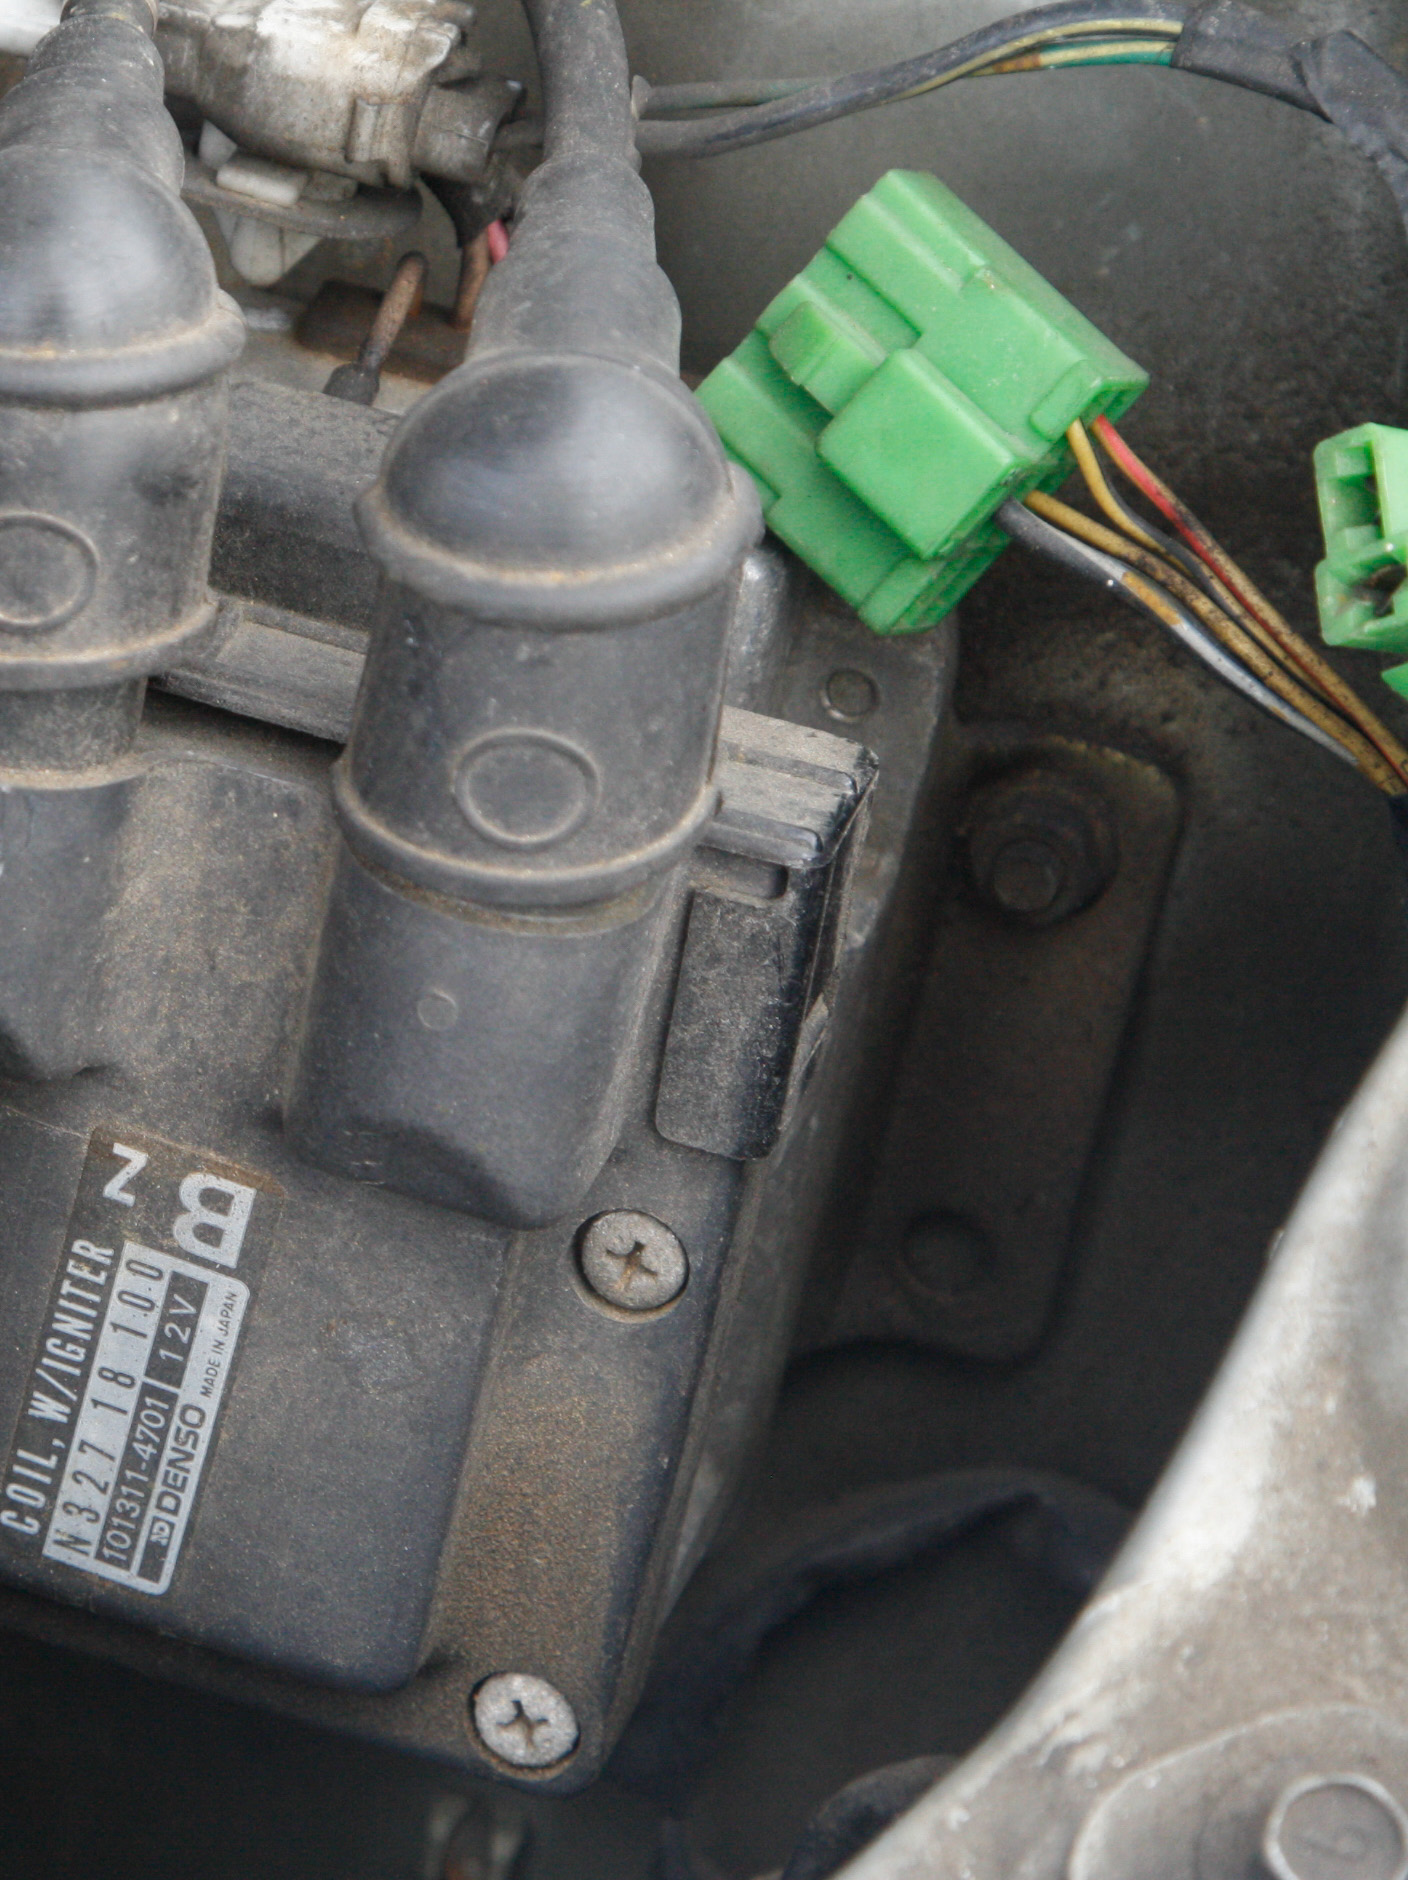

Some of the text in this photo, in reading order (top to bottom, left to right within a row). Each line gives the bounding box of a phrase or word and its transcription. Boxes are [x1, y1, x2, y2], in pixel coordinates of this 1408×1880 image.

[173, 1172, 257, 1269] B
[0, 1239, 114, 1535] COIL, W/IGNITER
[200, 1292, 238, 1399] MADE IN JAPAN
[102, 1396, 170, 1562] 101311-4701
[155, 1403, 206, 1517] DENSO
